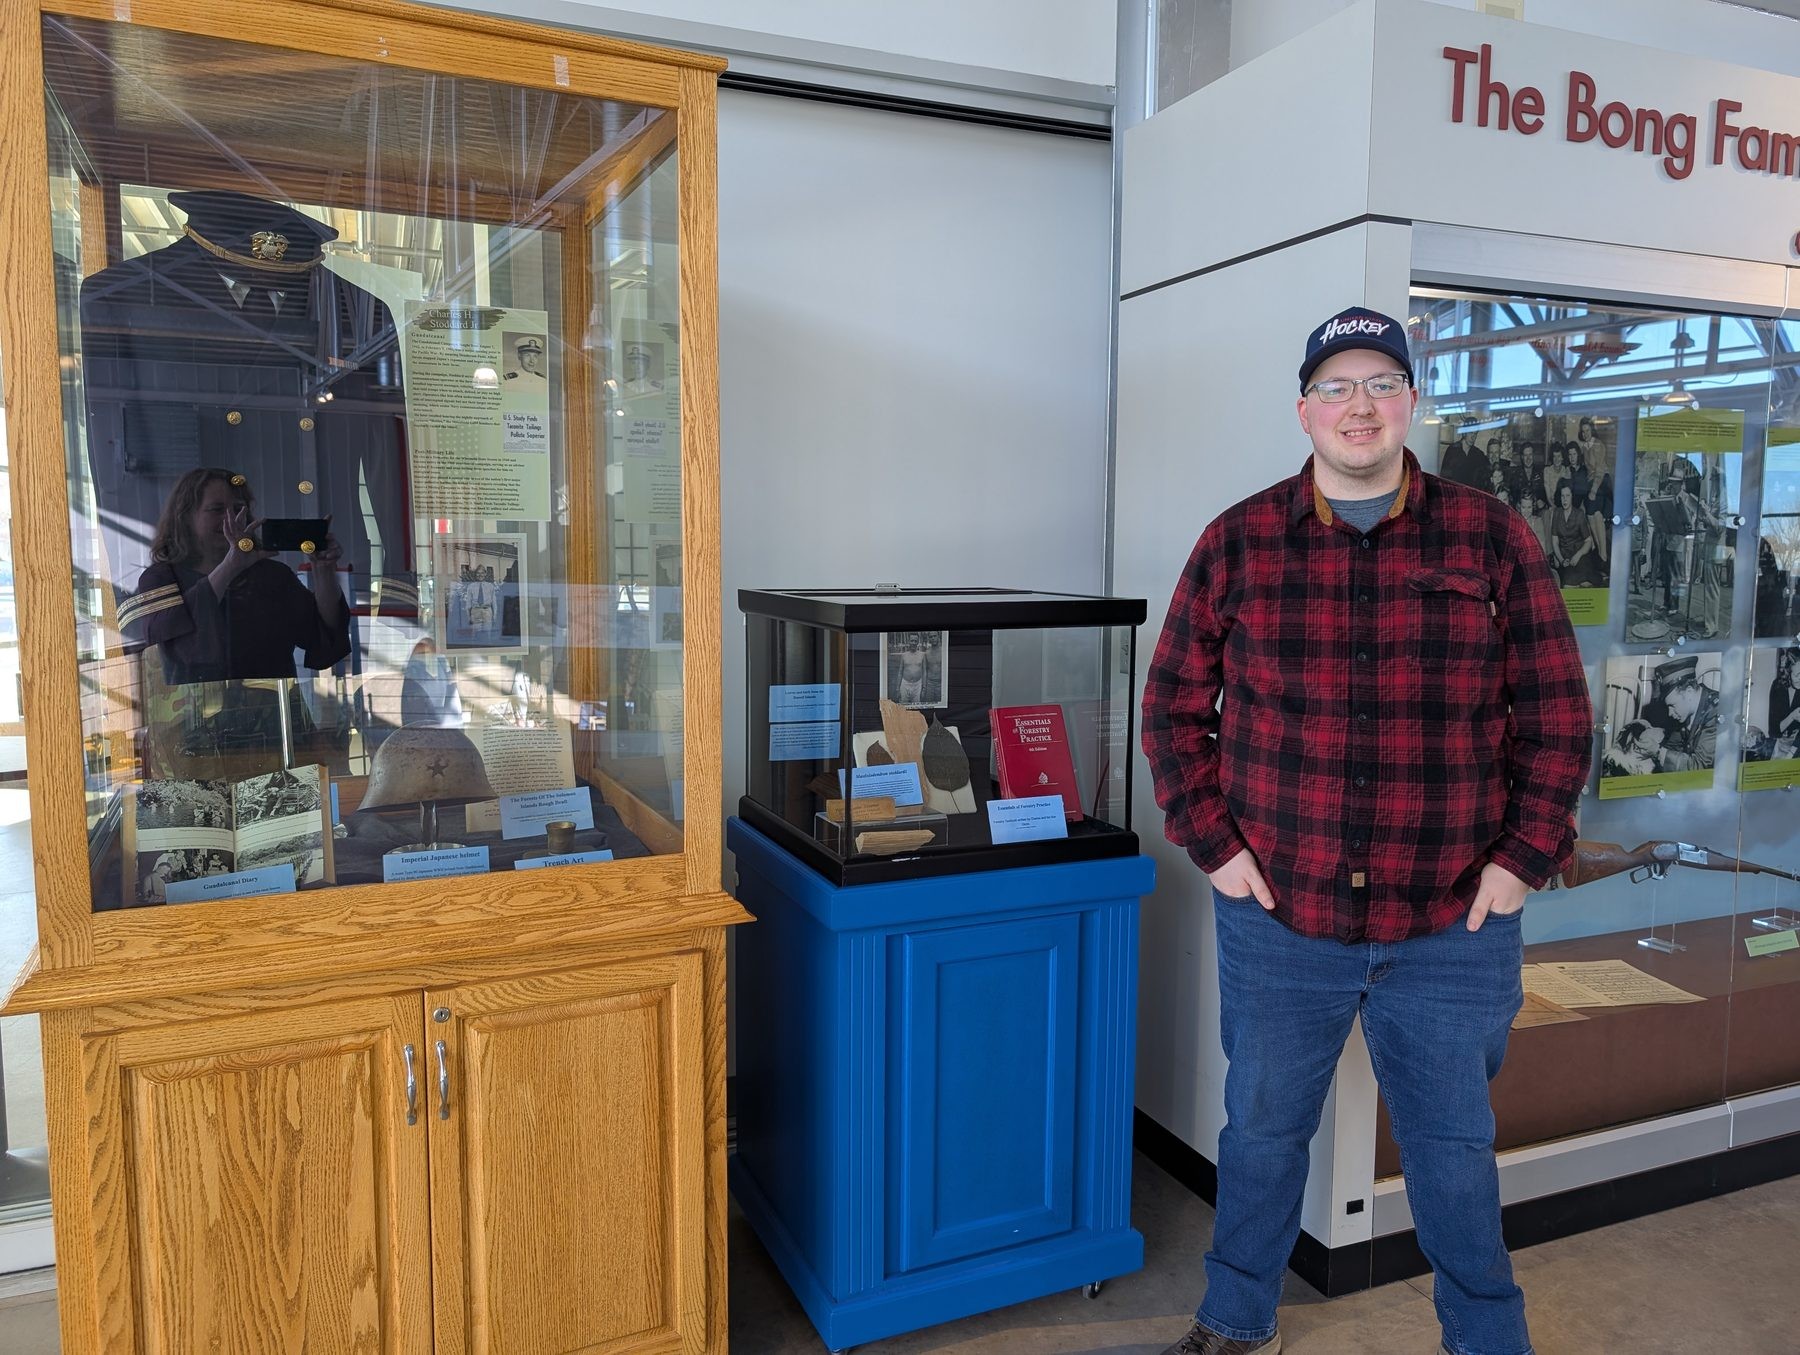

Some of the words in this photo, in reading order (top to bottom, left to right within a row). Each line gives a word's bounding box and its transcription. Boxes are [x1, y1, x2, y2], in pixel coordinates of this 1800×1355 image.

[1443, 43, 1545, 135] The
[1566, 70, 1697, 180] Bong
[1713, 98, 1800, 178] Fam
[429, 309, 462, 319] Charles
[430, 319, 469, 329] Stoddard
[411, 332, 445, 340] Guadalcanal
[1319, 318, 1390, 345] HOCKEY
[1014, 718, 1052, 727] ESSENTIALS
[1019, 726, 1050, 735] FORESTRY
[1020, 734, 1053, 743] PRACTICE
[401, 855, 429, 865] Imperial
[430, 853, 459, 863] Japanese
[459, 851, 480, 859] helmet
[542, 858, 570, 868] Trench
[571, 856, 585, 865] Art
[203, 879, 241, 890] Guadalcanal
[241, 877, 258, 885] Diary
